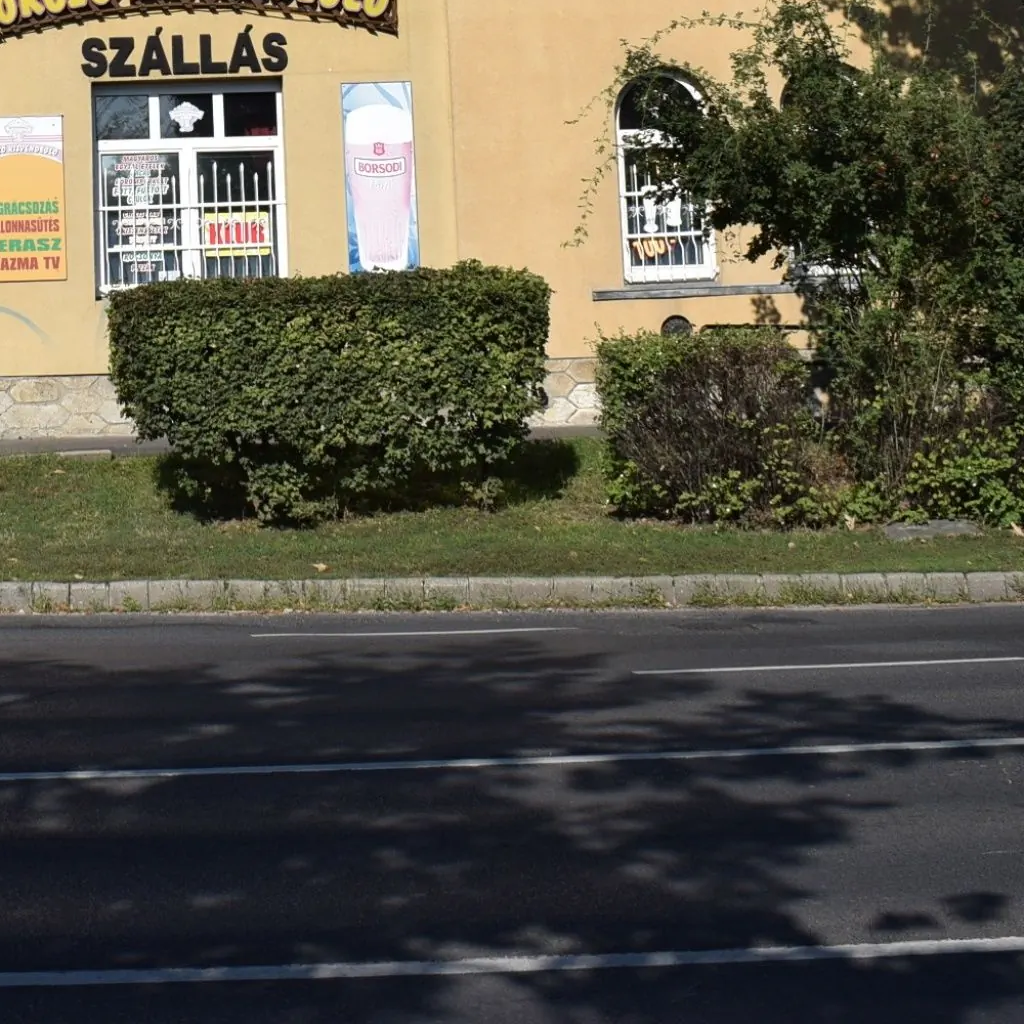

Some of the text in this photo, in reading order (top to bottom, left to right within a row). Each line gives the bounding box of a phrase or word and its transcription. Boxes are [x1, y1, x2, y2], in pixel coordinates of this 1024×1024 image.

[81, 24, 288, 78] SZÁLLÁS
[358, 161, 402, 174] BORSODI
[43, 256, 60, 270] TV
